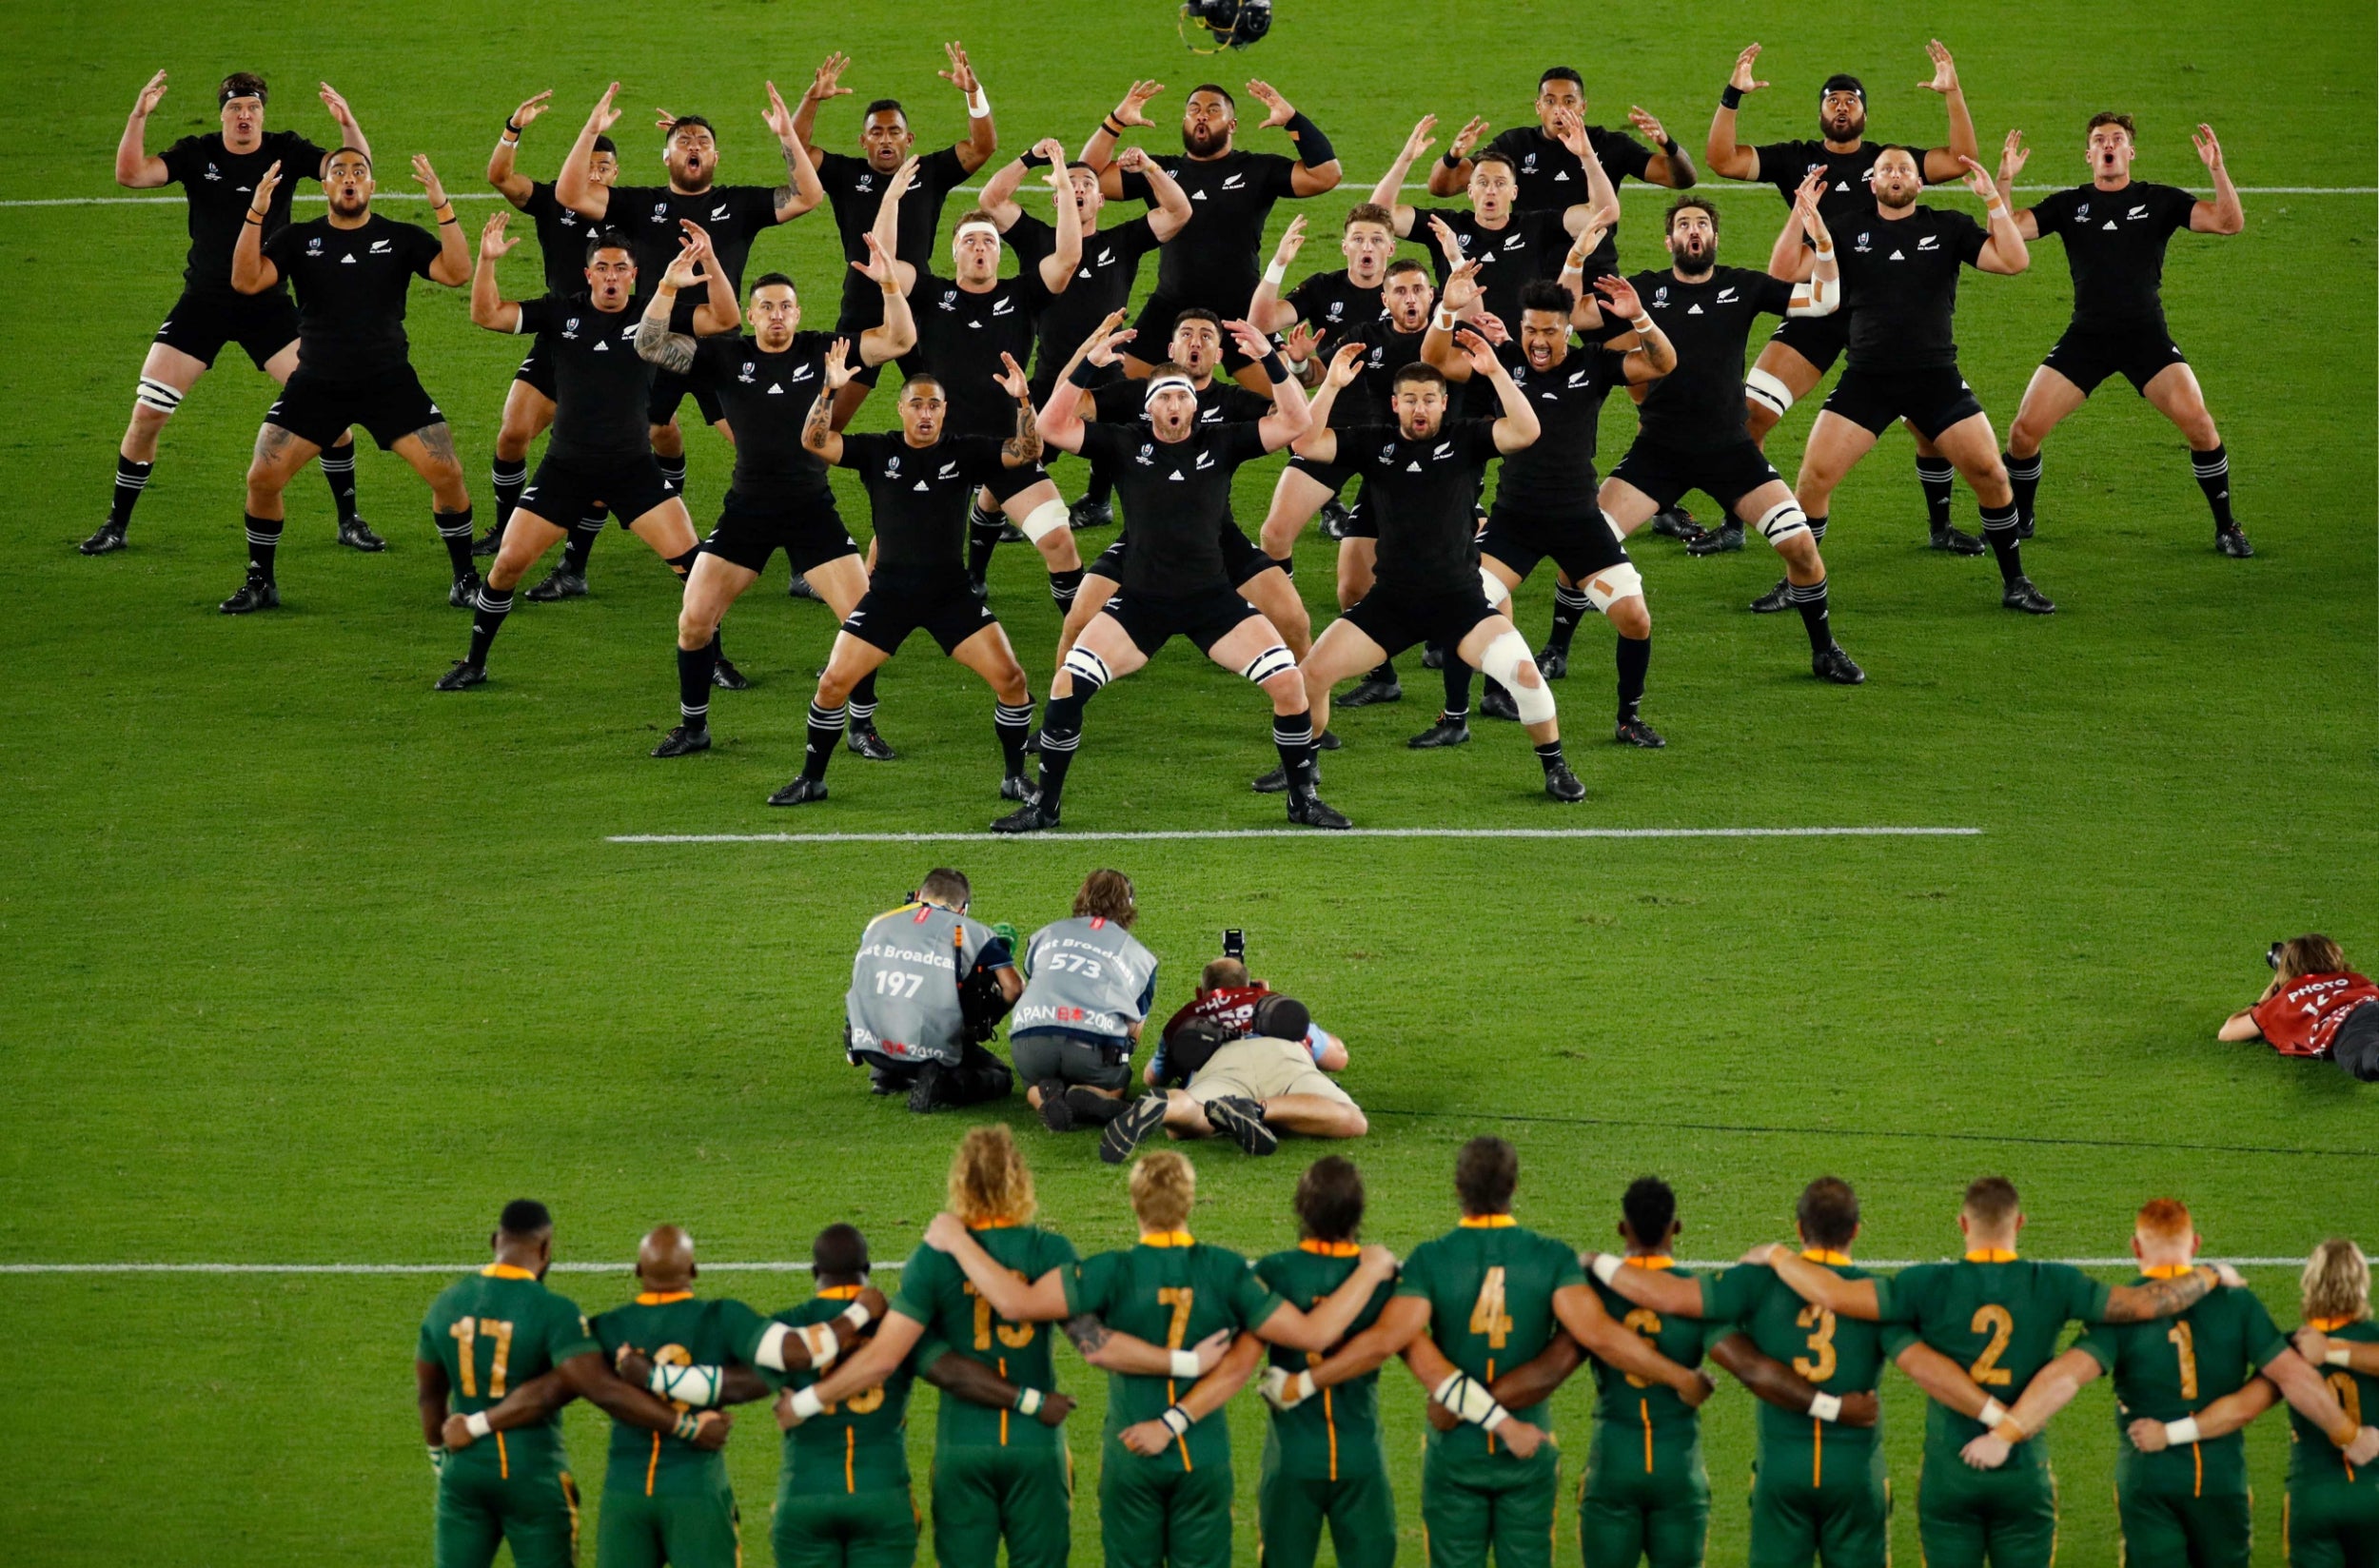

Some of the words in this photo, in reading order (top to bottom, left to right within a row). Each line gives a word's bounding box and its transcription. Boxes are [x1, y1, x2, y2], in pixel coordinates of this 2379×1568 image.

[875, 970, 924, 999] 197
[884, 945, 955, 970] Broadca
[1048, 952, 1101, 979] 573
[1013, 1005, 1056, 1029] APAN
[2288, 978, 2350, 1003] PHOTO
[1157, 1287, 1194, 1350] 7
[1469, 1267, 1515, 1349] 4
[449, 1316, 514, 1399] 17
[1792, 1304, 1838, 1383] 3
[1969, 1304, 2014, 1385] 2
[2168, 1320, 2198, 1400] 1
